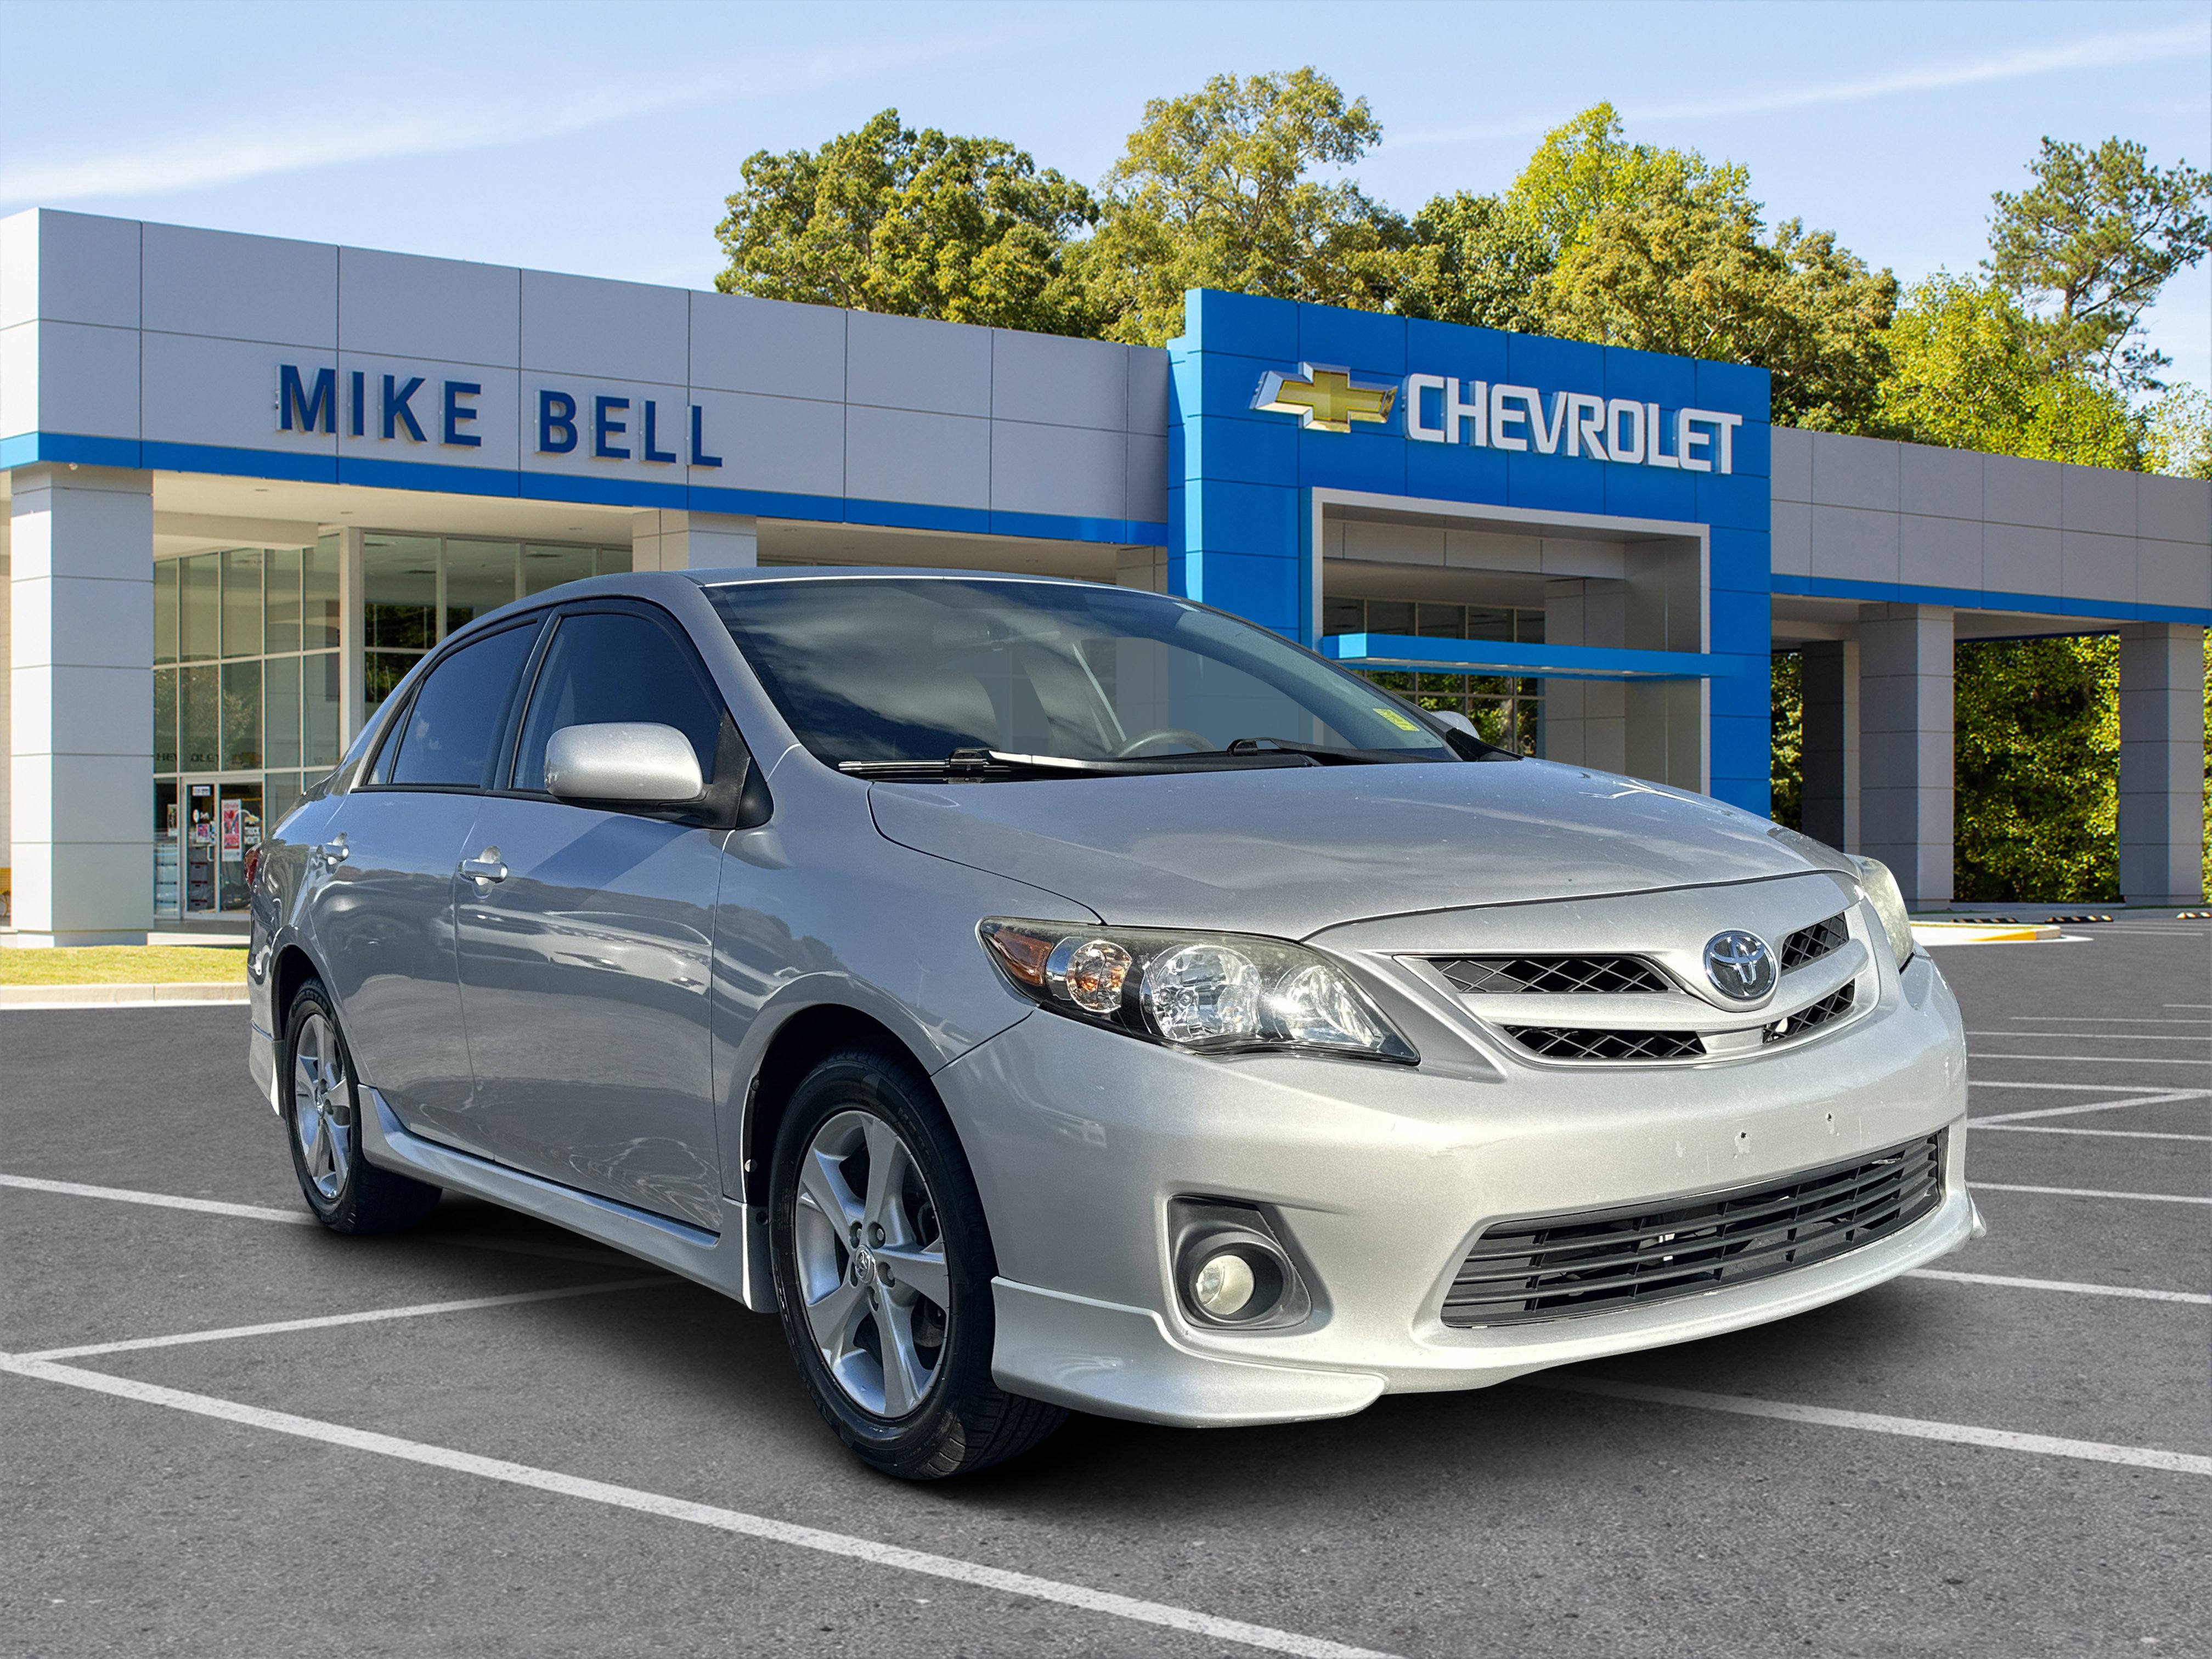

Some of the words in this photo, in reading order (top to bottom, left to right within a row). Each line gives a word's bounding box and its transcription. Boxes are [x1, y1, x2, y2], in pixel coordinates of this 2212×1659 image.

[276, 364, 482, 447] MIKE
[535, 389, 723, 468] BELL
[1404, 373, 1742, 475] CHEVROLET
